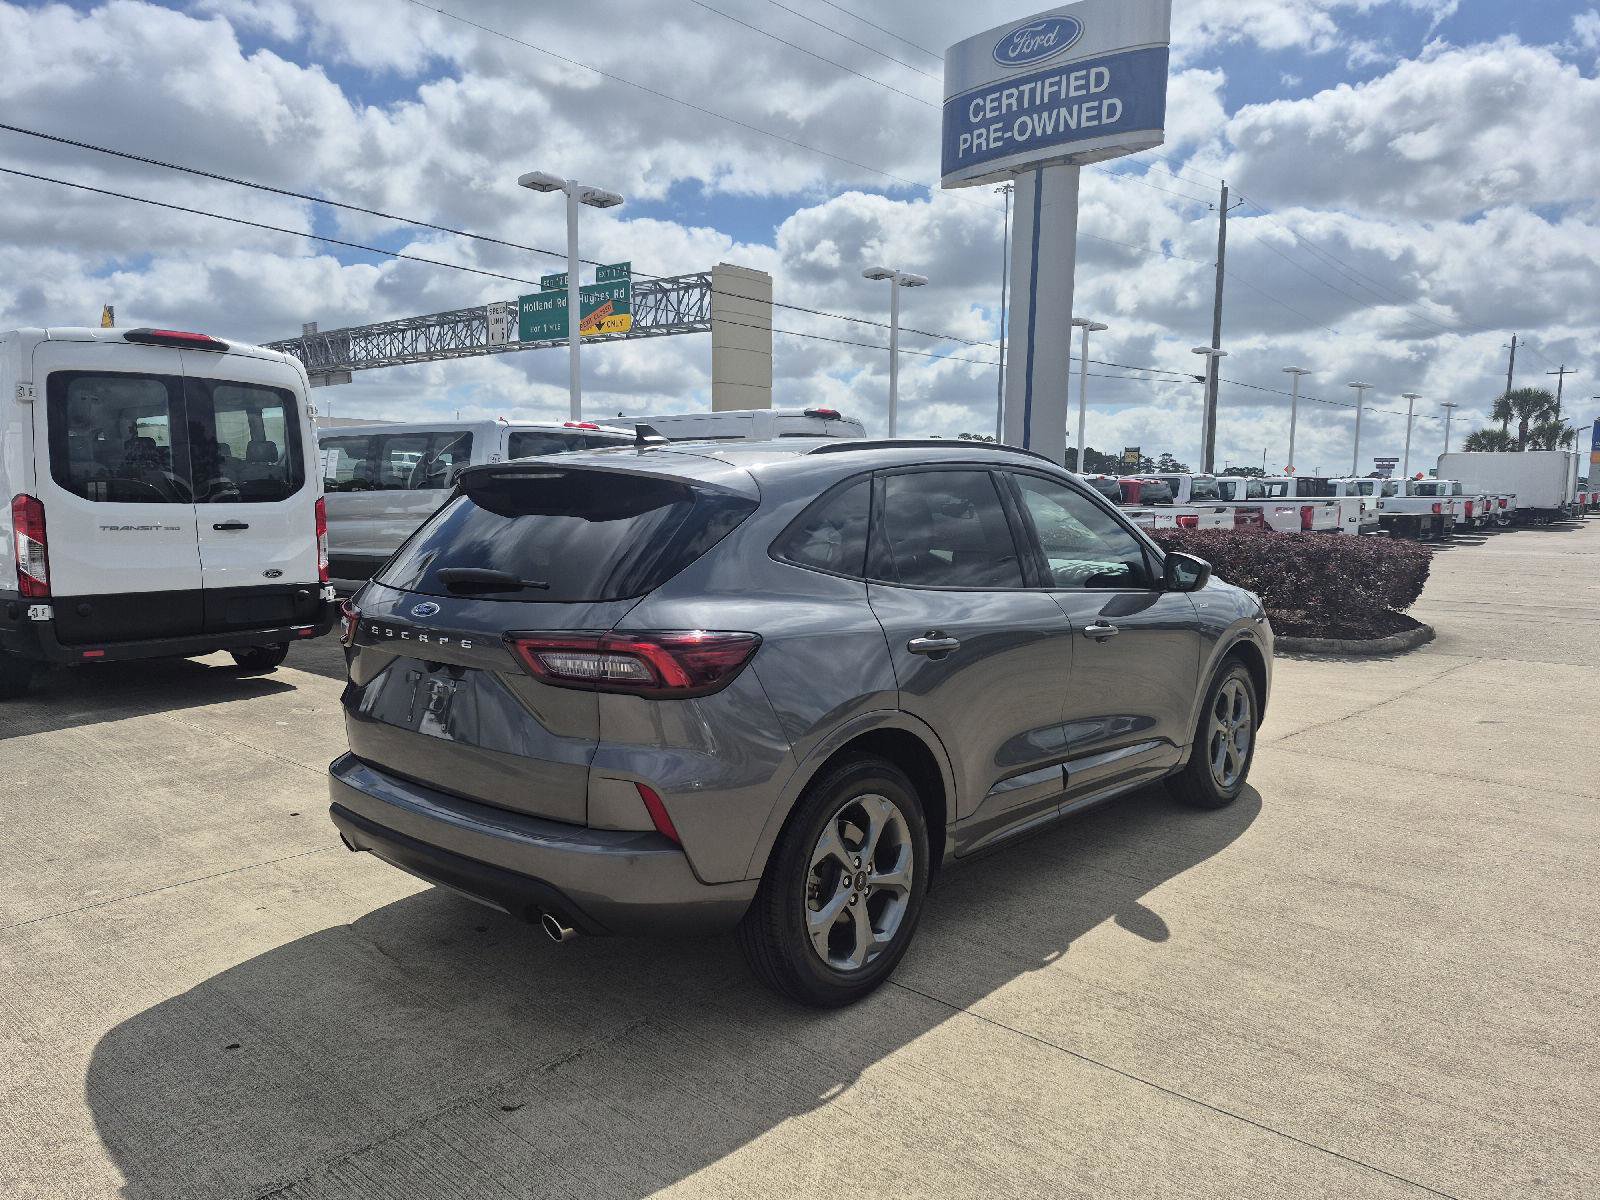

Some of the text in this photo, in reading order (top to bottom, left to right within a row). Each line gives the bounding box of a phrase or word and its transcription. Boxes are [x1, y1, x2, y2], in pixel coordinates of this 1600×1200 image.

[1008, 22, 1061, 59] Ford
[968, 65, 1111, 124] CERTIFIED
[957, 97, 1124, 159] PRE-OWNED
[523, 296, 567, 313] Holland Rd
[579, 287, 625, 305] Hughes Rd
[489, 306, 506, 316] SPEED
[606, 318, 624, 328] ONLY
[371, 625, 473, 649] ESCAPE
